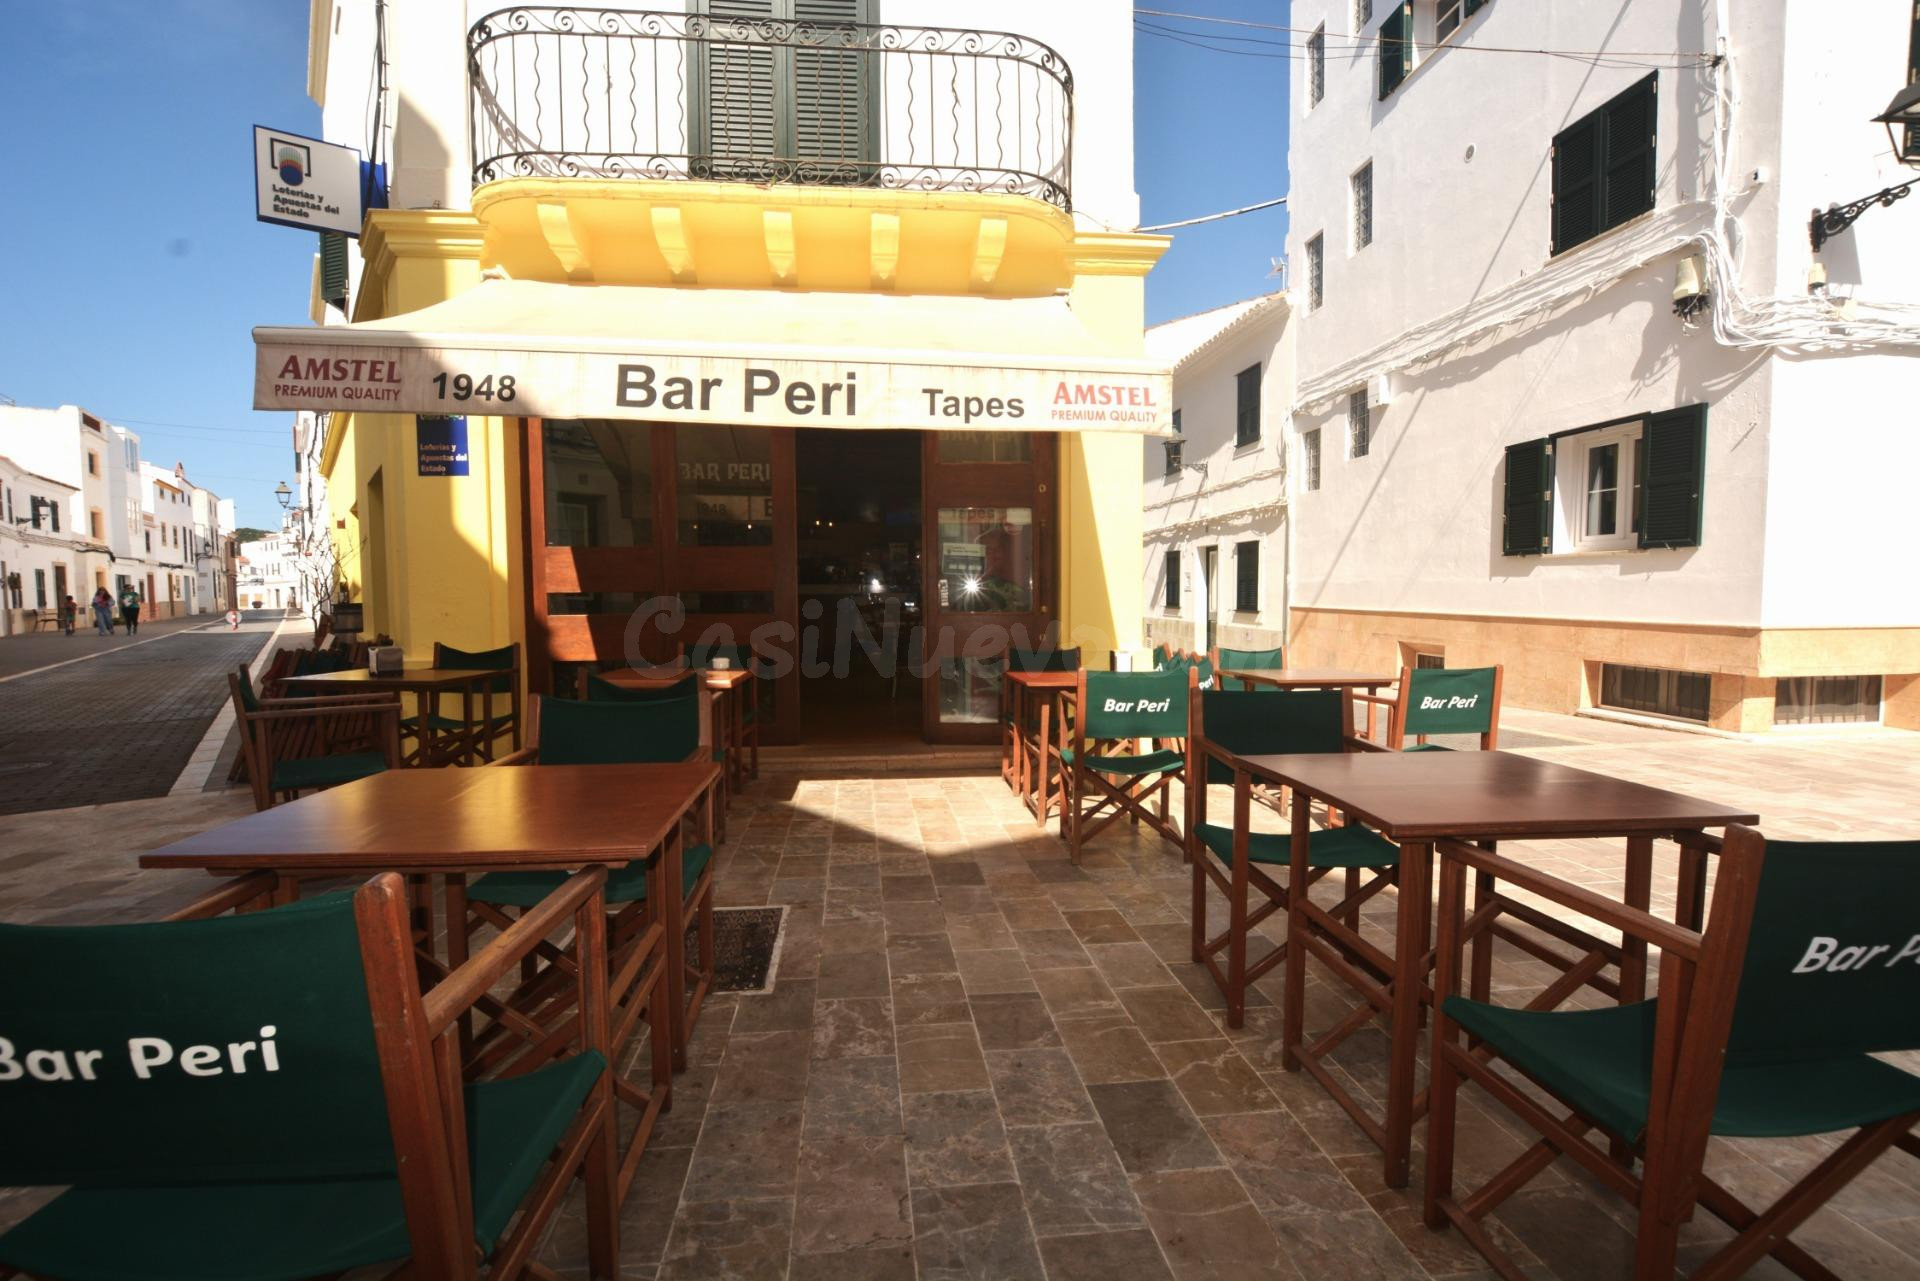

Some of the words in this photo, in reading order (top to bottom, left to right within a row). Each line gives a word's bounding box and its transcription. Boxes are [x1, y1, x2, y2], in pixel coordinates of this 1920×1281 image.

[273, 195, 321, 211] Apuestas
[324, 205, 340, 215] del
[317, 195, 324, 203] y
[273, 204, 310, 218] Estado
[278, 355, 402, 384] AMSTEL
[274, 384, 338, 399] PREMIUM
[343, 386, 401, 401] QUALITY
[432, 372, 516, 402] 1948
[616, 364, 723, 411] Bar
[744, 368, 856, 416] Peri
[1053, 381, 1157, 407] AMSTEL
[922, 388, 1025, 424] Tapes
[1051, 410, 1106, 422] PREMIUM
[1110, 410, 1157, 423] QUALITY
[451, 444, 457, 452] y
[455, 453, 468, 461] del
[679, 462, 720, 482] BAR
[727, 462, 771, 482] PERI
[1104, 698, 1135, 712] Bar
[1136, 698, 1170, 712] Peri
[1420, 696, 1447, 709] Bar
[1447, 694, 1479, 708] Peri
[1791, 936, 1891, 973] Bar
[128, 1025, 280, 1079] Peri
